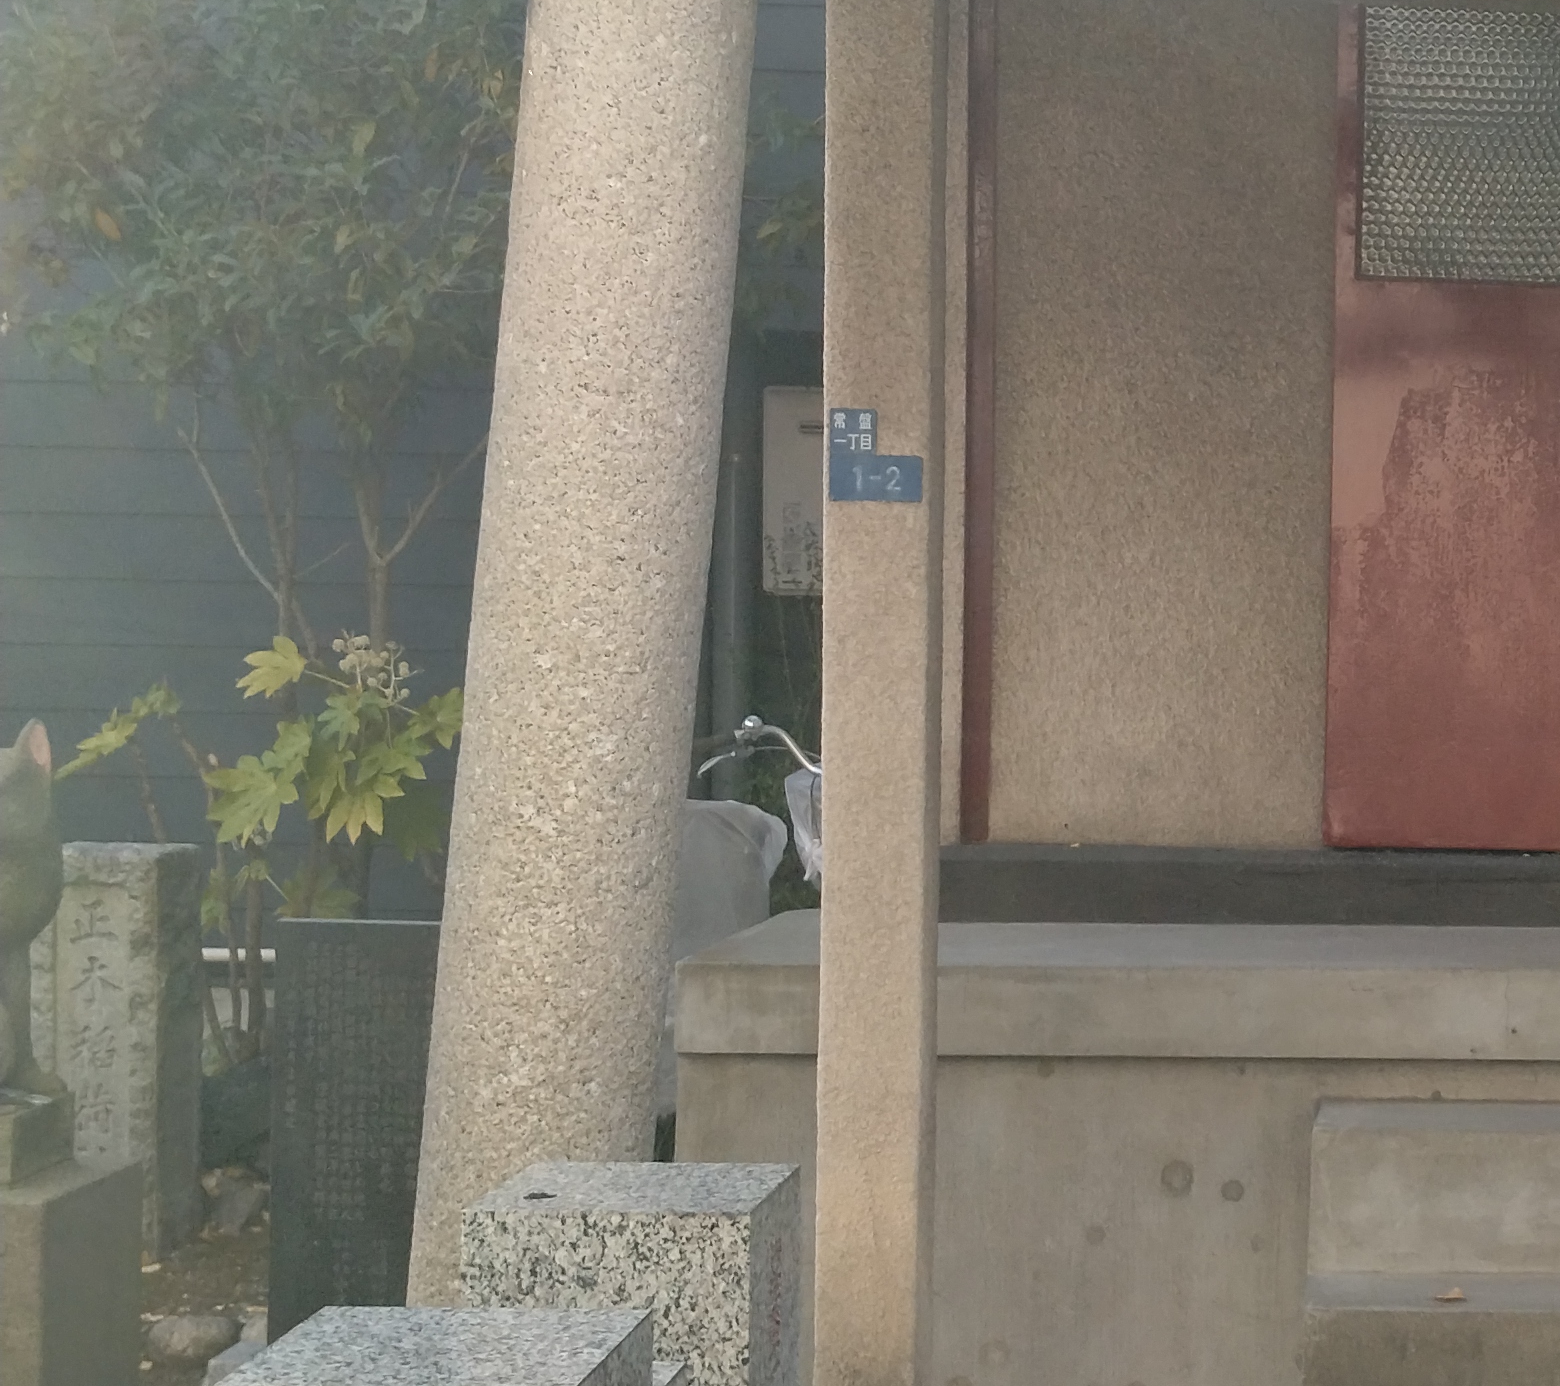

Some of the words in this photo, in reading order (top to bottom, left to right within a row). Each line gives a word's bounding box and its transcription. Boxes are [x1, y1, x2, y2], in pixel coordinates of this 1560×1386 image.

[833, 412, 872, 430] 常盤
[834, 433, 872, 450] 一丁目
[852, 465, 901, 491] 1-2
[69, 899, 123, 1151] 正木稲荷
